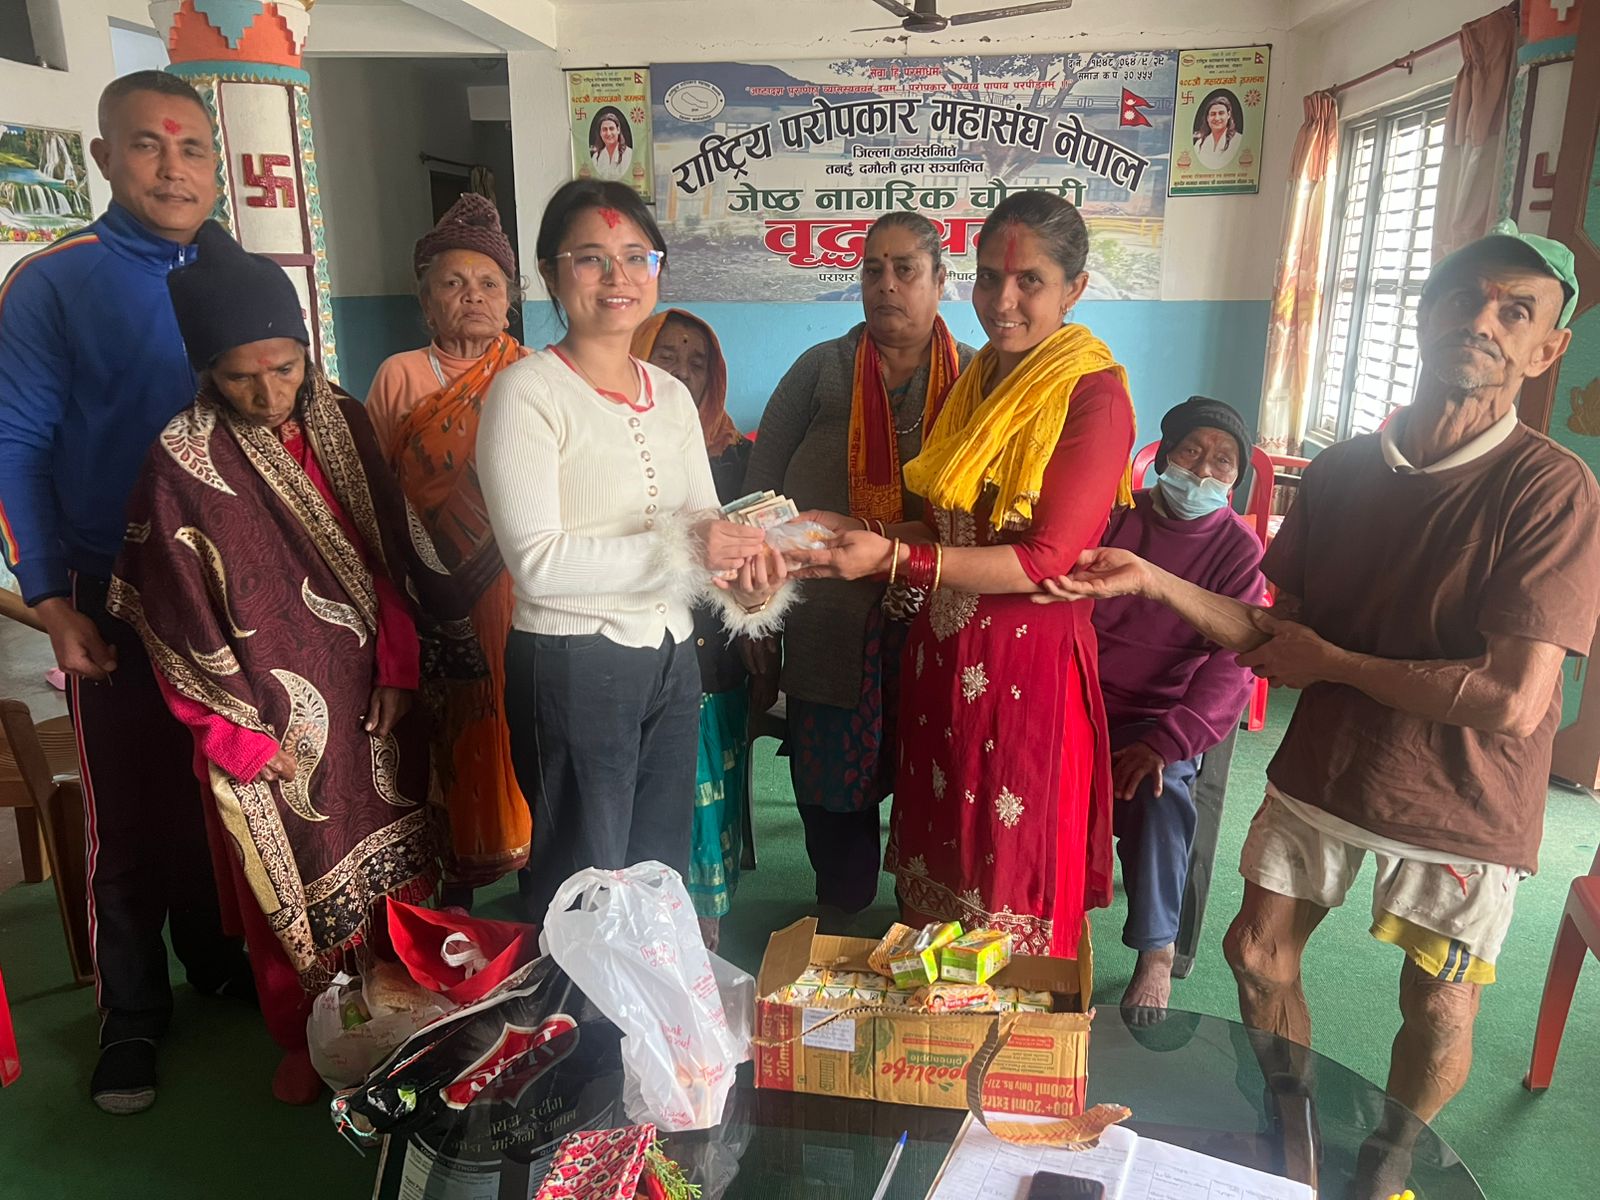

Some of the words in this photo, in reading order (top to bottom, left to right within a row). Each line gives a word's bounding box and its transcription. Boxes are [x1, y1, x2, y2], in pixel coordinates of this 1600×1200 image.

[672, 124, 772, 194] राष्ट्रिय
[780, 98, 922, 148] परोपकार
[932, 99, 1048, 151] महासंघ
[1055, 115, 1148, 192] नेपाल
[853, 145, 890, 158] जिल्ला
[894, 144, 957, 158] कार्यसमिति
[859, 161, 896, 174] दमौली
[901, 162, 925, 176] द्वारा
[929, 160, 985, 174] सञ्चालित
[727, 182, 804, 212] जेष्ठ
[815, 180, 957, 211] नागरिक
[819, 273, 856, 282] पराशर
[910, 1053, 963, 1066] pineapple
[1014, 1080, 1033, 1092] Only
[1034, 1083, 1075, 1098] 200ml
